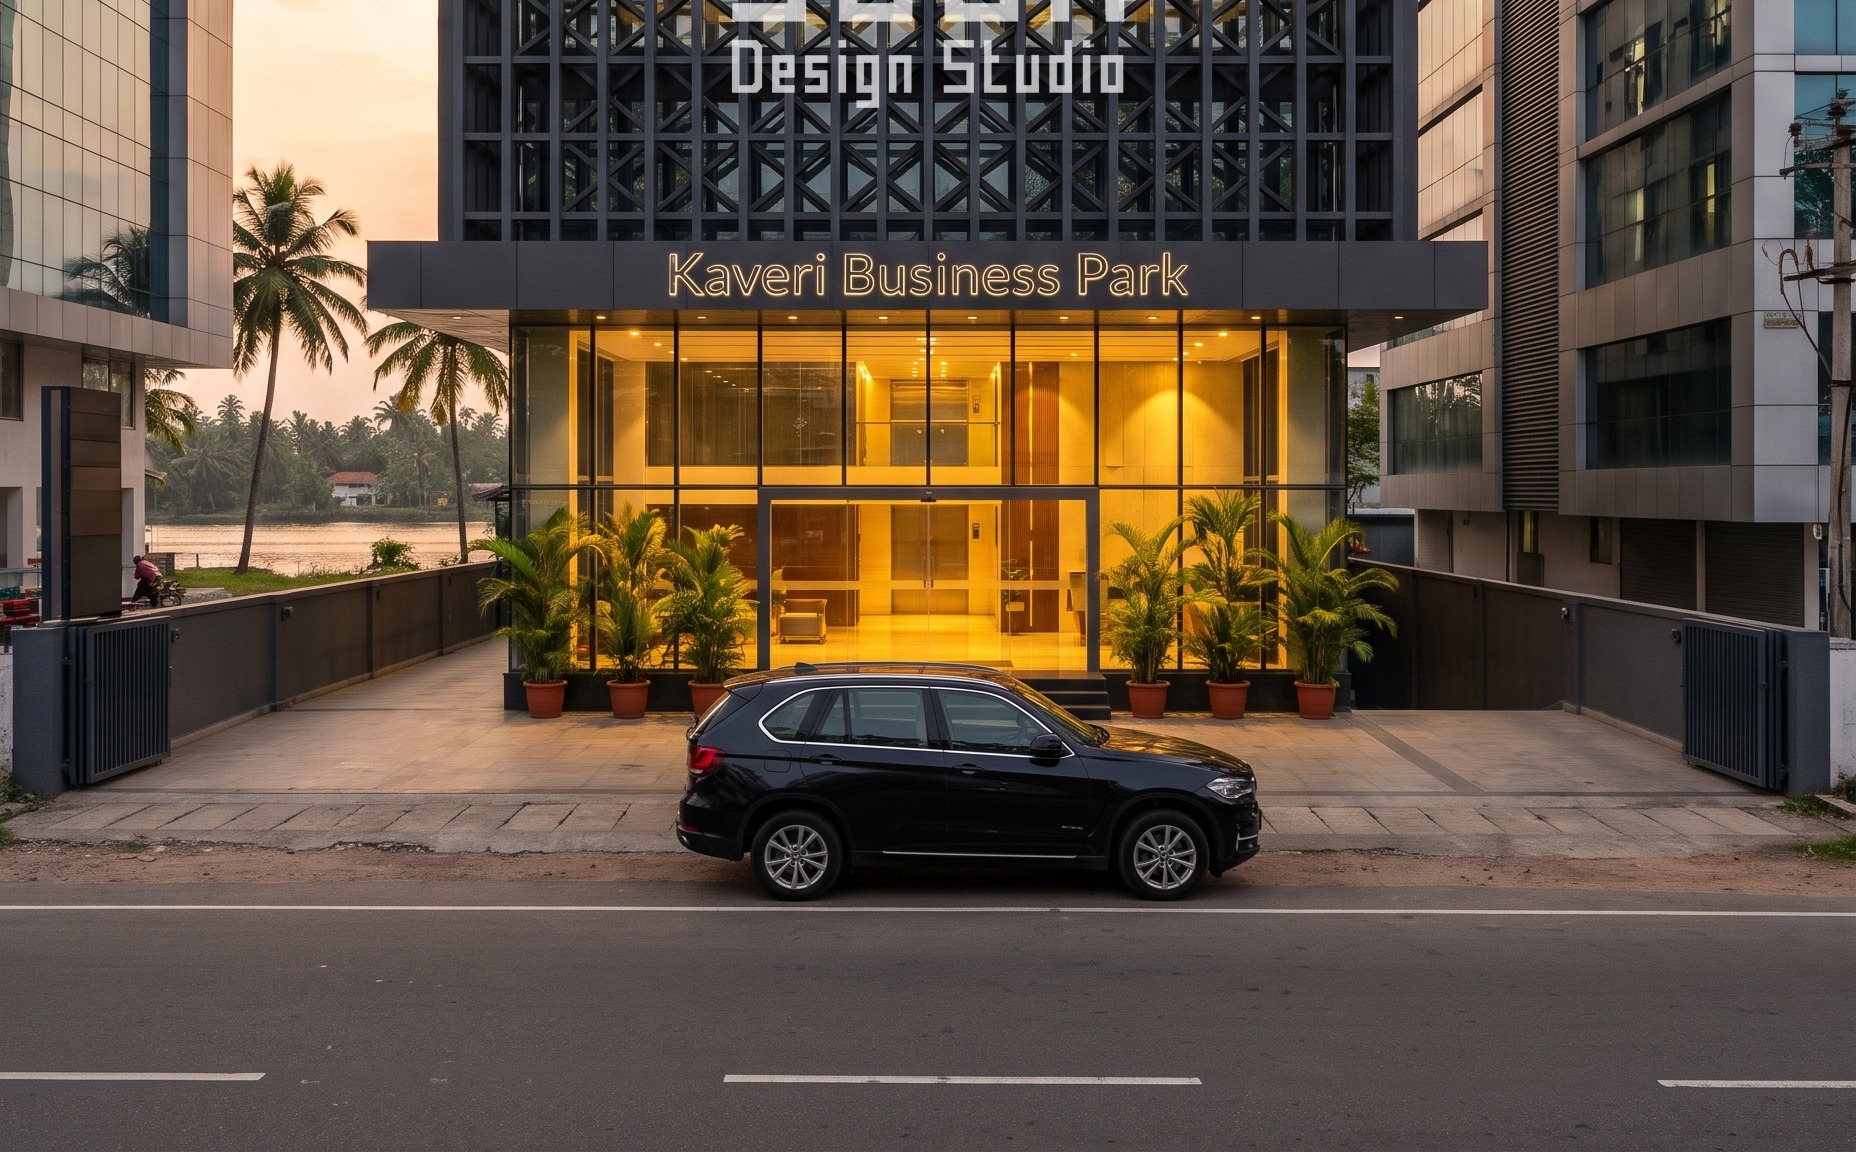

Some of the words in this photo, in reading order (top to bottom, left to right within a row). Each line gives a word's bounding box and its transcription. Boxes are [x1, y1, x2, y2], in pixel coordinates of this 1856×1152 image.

[668, 252, 826, 296] Kaveri
[843, 252, 1060, 296] Business
[1077, 252, 1189, 296] Park
